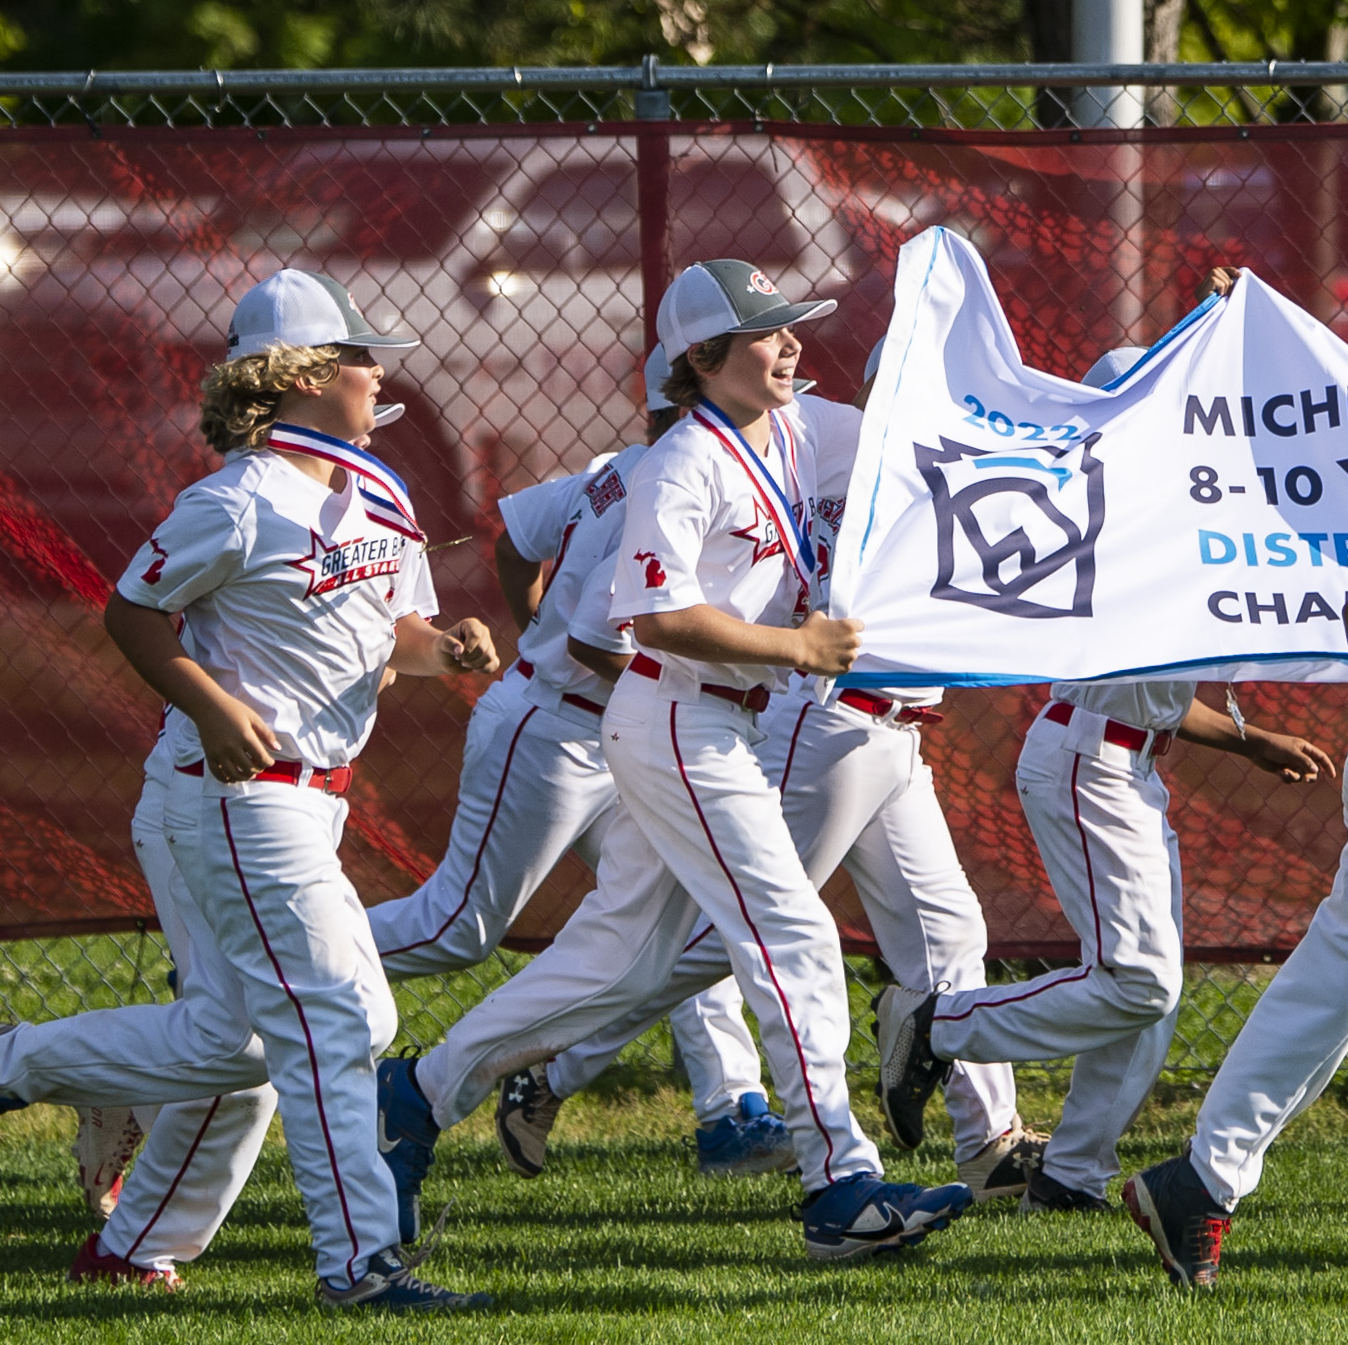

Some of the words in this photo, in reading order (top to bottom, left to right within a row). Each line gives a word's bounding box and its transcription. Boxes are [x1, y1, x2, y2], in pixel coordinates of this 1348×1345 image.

[962, 393, 1083, 442] 2022
[1189, 464, 1324, 507] 8-10
[320, 537, 388, 577] GREATER
